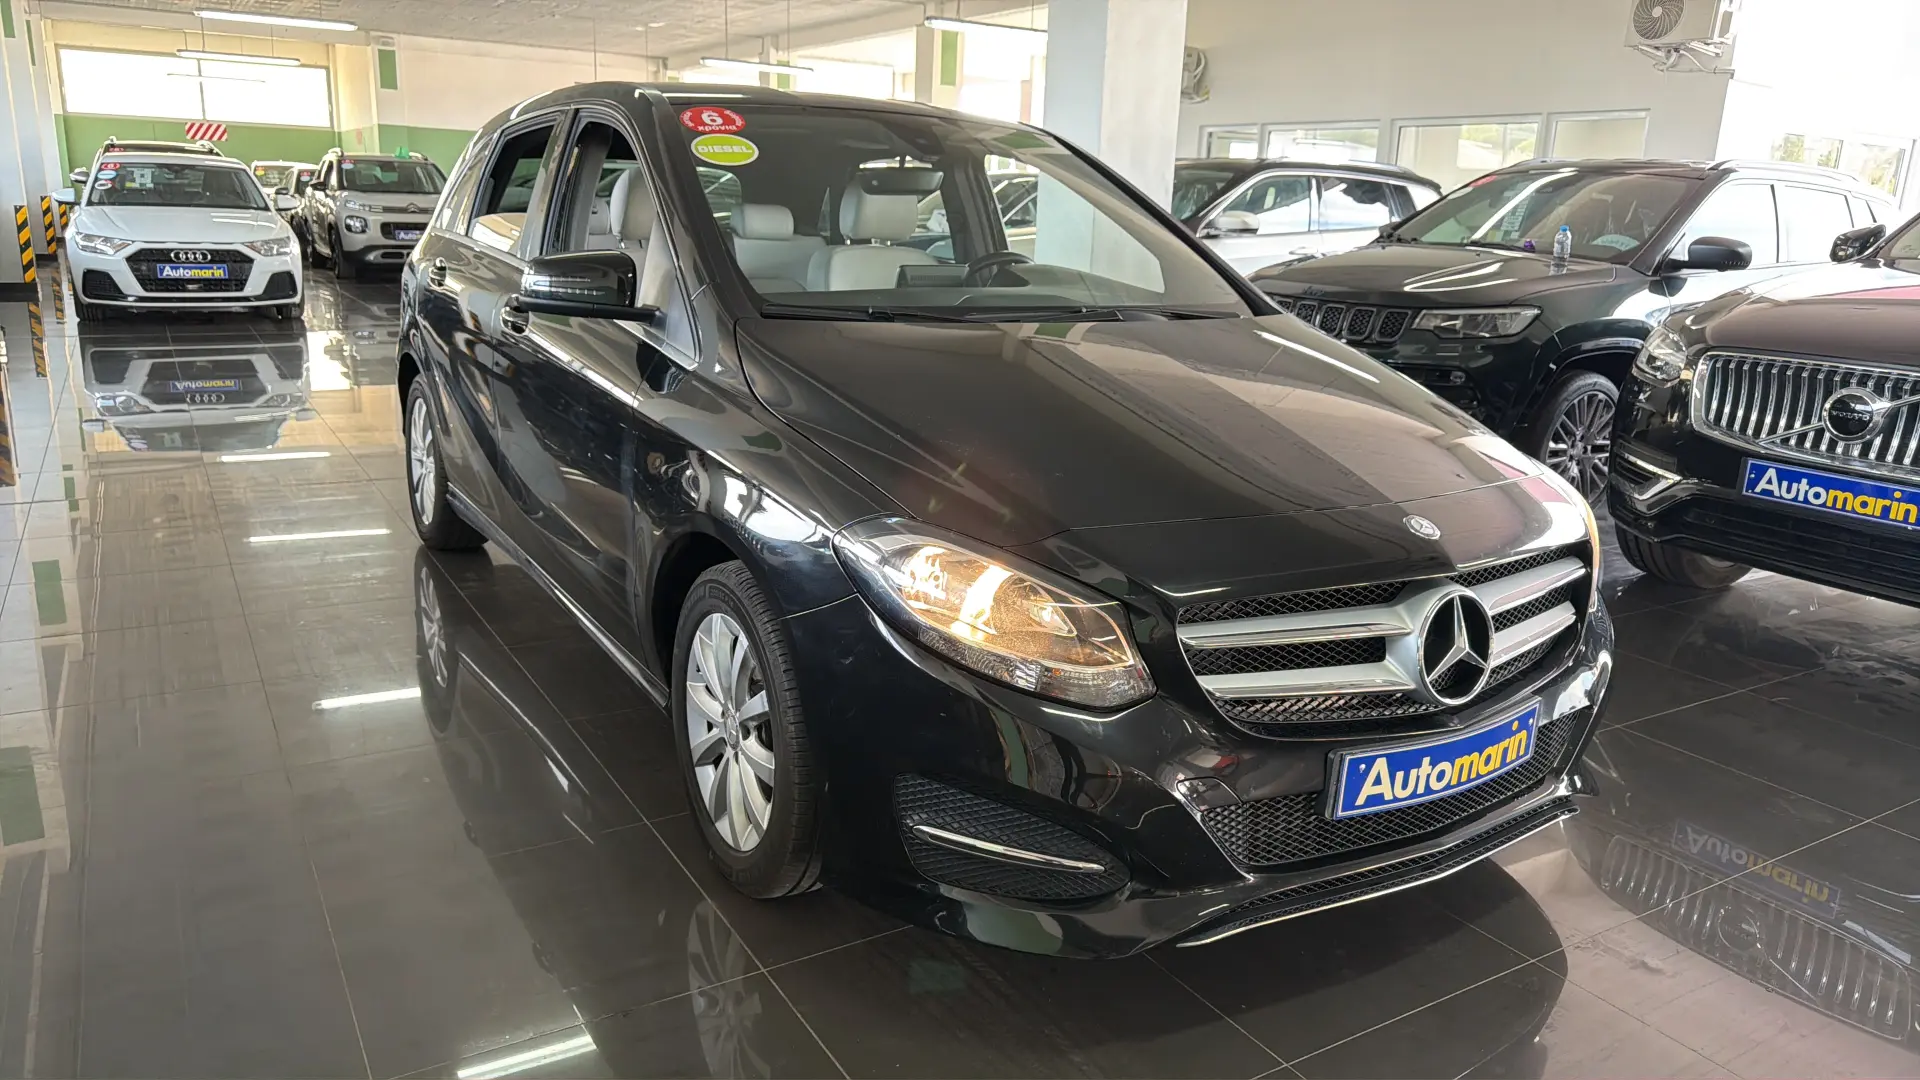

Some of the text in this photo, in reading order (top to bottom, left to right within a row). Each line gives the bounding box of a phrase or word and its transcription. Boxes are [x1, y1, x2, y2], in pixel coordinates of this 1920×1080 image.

[701, 112, 723, 125] 6
[697, 145, 753, 153] DIESEL
[162, 265, 224, 277] Automarin
[1754, 467, 1919, 525] Automarin
[1354, 720, 1529, 807] Automarin
